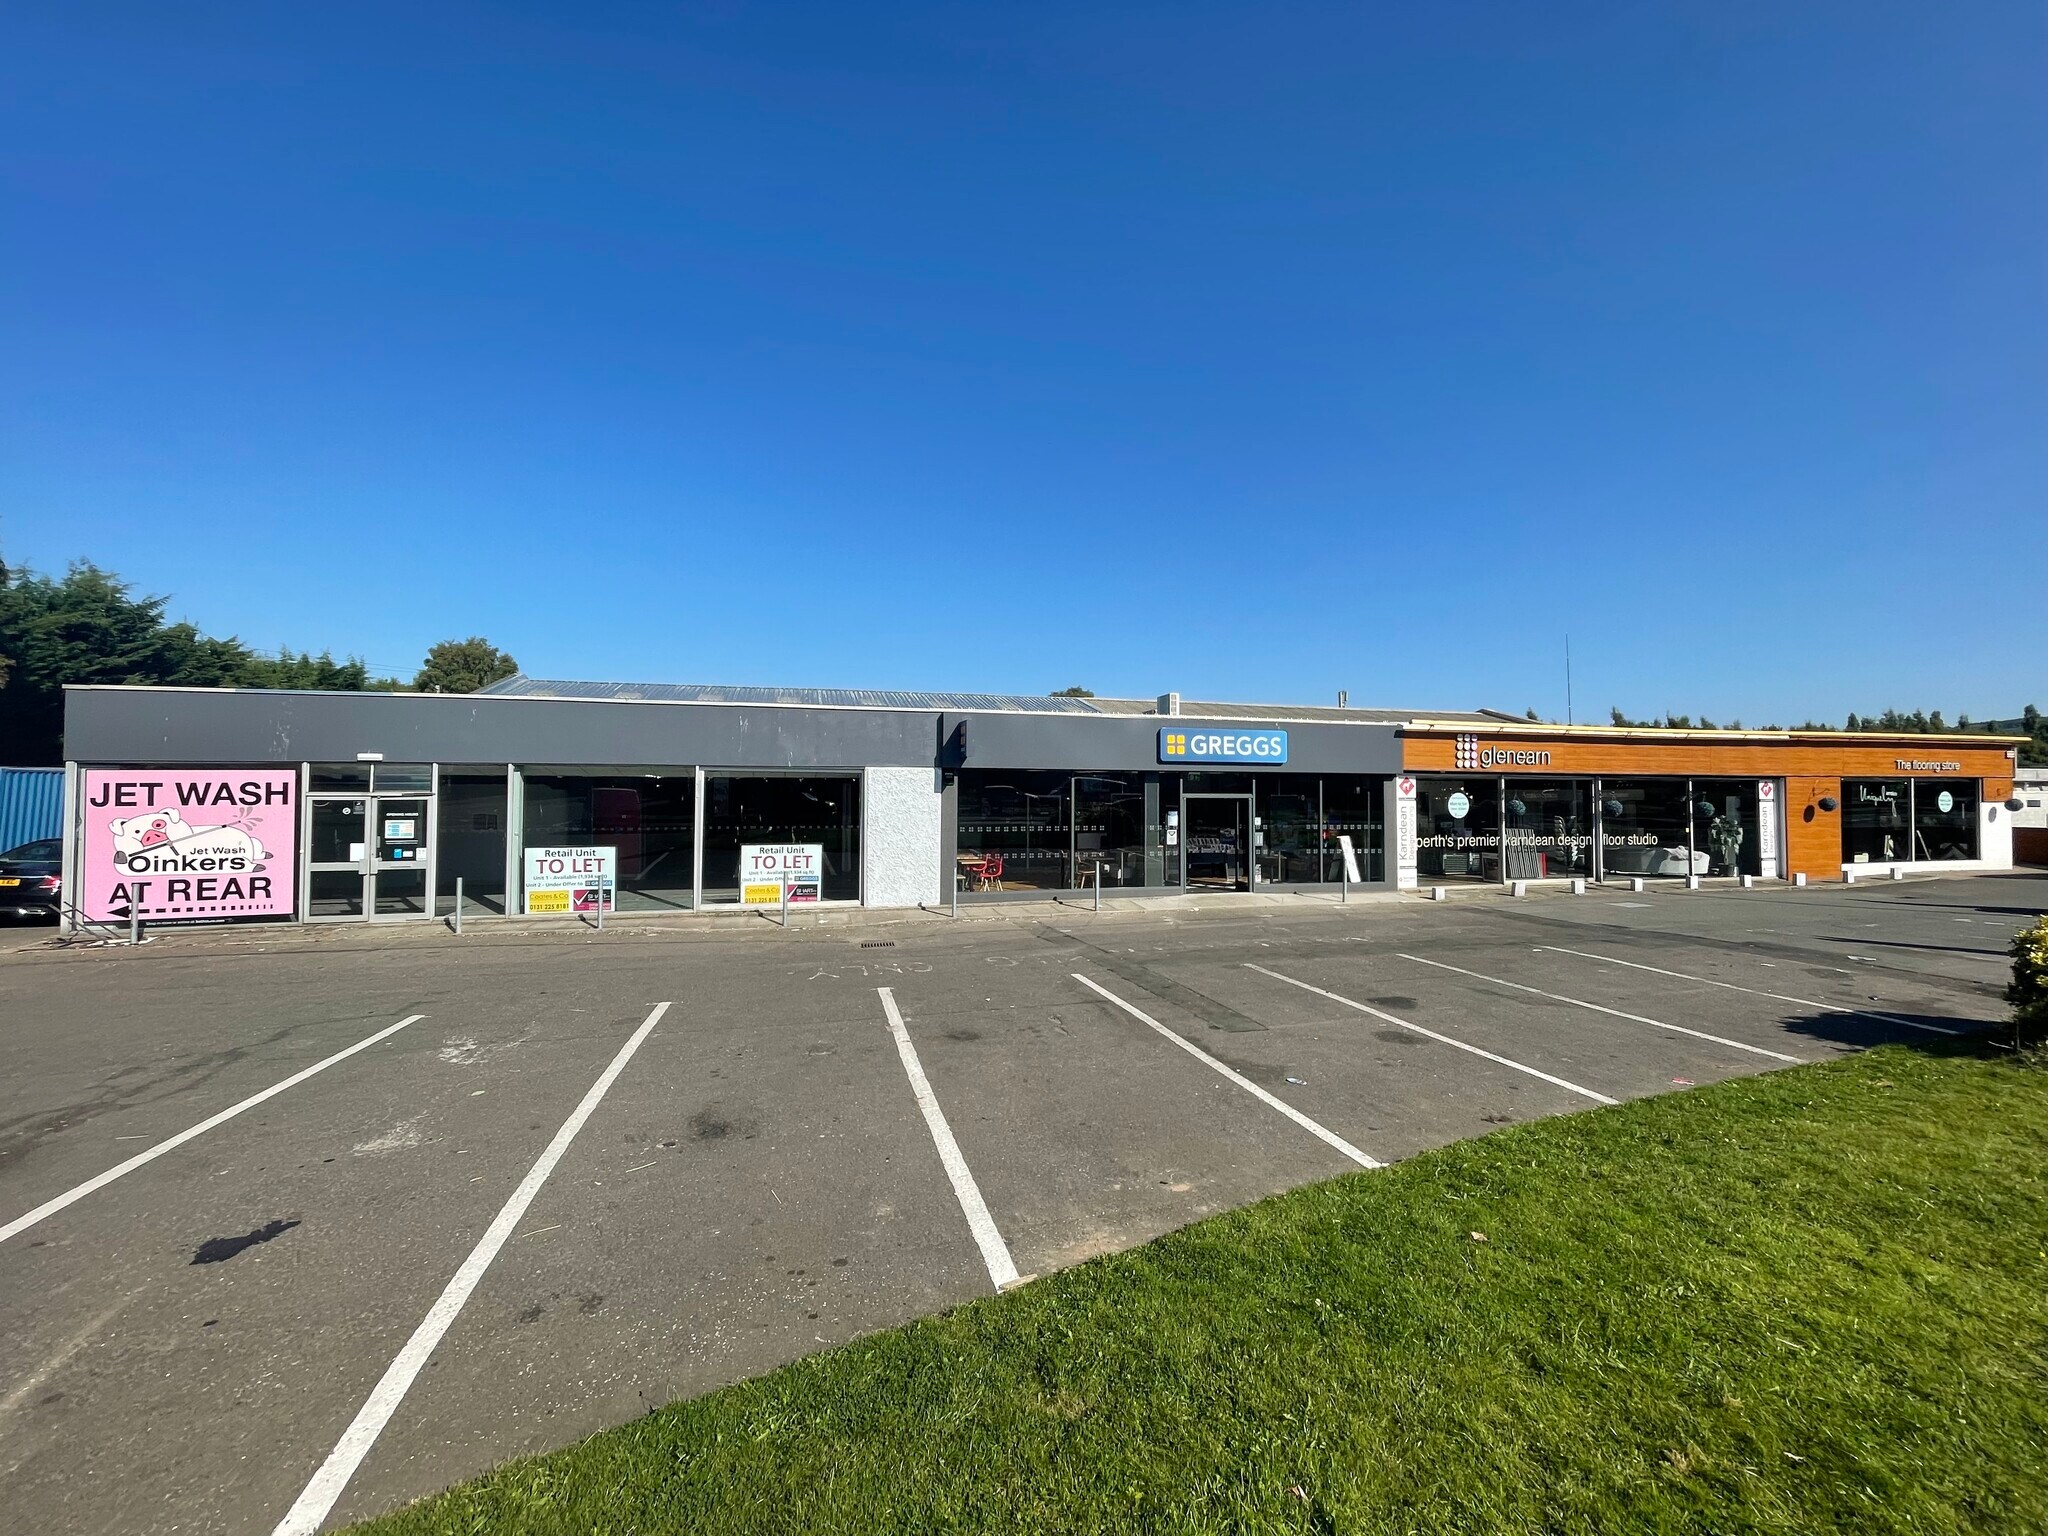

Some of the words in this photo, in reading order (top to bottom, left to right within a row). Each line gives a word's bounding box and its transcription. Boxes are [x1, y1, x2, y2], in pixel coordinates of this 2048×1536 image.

[1190, 735, 1282, 756] GREGGS
[1481, 745, 1551, 768] glenearn
[1896, 759, 1911, 770] The
[1912, 760, 1940, 773] flooring
[1941, 760, 1960, 770] store
[90, 782, 163, 807] JET
[175, 781, 289, 806] WASH
[1399, 806, 1408, 861] Karndean
[1415, 834, 1454, 852] perth's
[1457, 833, 1501, 851] premier
[1503, 833, 1554, 846] karndean
[1557, 833, 1592, 849] design
[1602, 833, 1625, 846] floor
[1627, 833, 1658, 846] studio
[190, 847, 208, 855] Jet
[545, 849, 572, 857] Retail
[576, 849, 596, 857] Unit
[128, 855, 246, 873] Oinkers
[536, 859, 565, 874] TO
[572, 858, 605, 873] LET
[751, 855, 776, 869] TO
[783, 855, 813, 869] LET
[108, 882, 152, 904] AT
[168, 877, 272, 902] REAR
